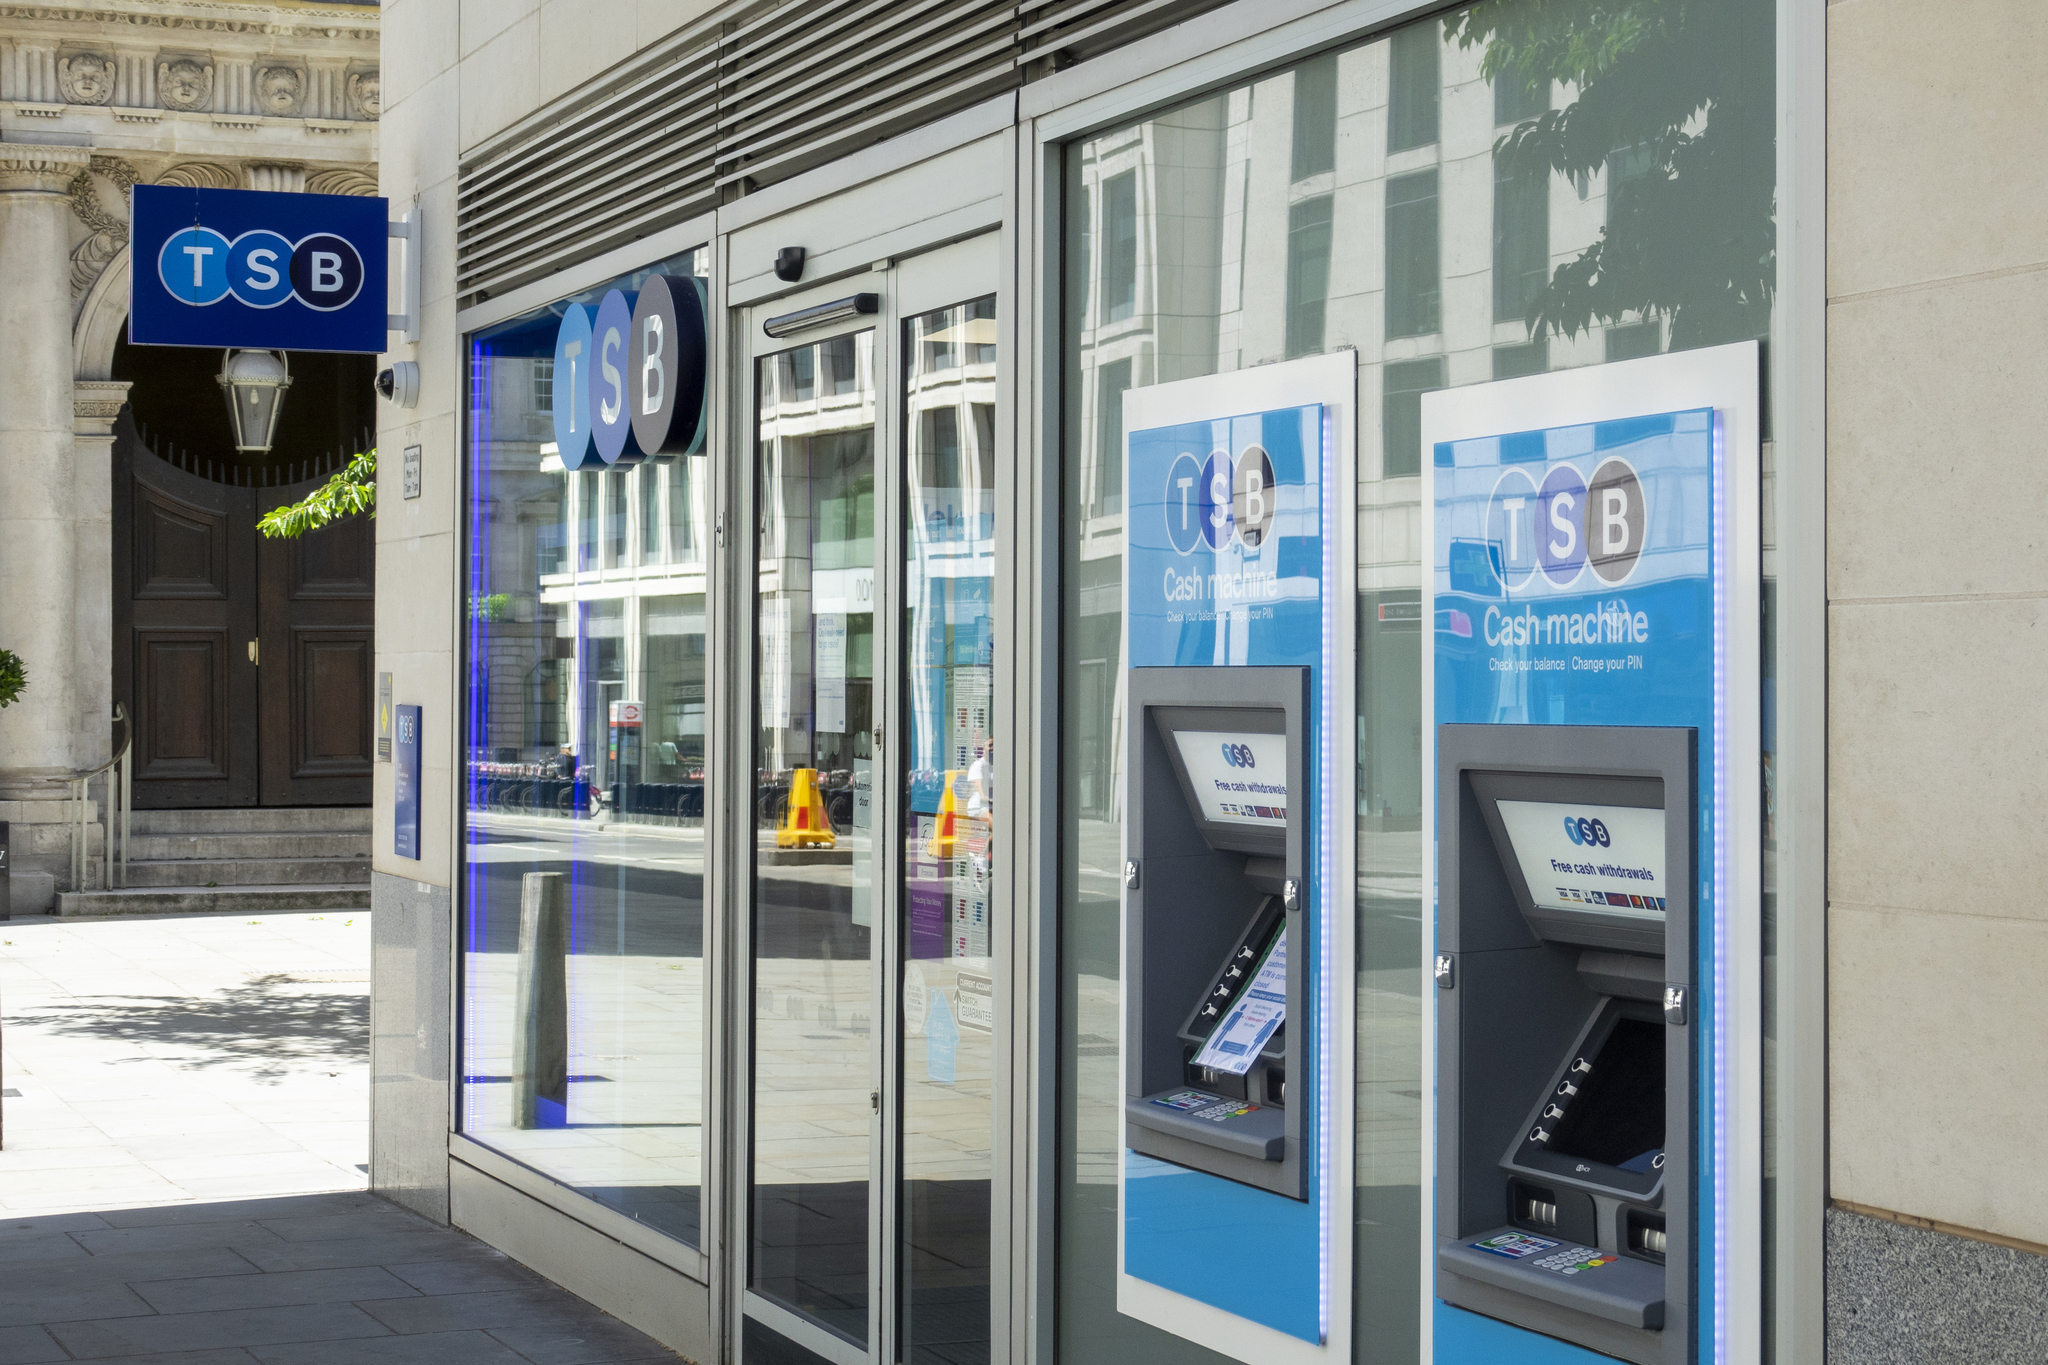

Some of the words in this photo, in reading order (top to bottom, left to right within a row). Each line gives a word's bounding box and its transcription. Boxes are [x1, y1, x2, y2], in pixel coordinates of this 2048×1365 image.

[182, 246, 344, 293] TSB
[564, 314, 665, 434] TSB
[1177, 469, 1265, 530] TSB
[1503, 487, 1630, 561] TSB
[1163, 566, 1203, 602] Cash
[1208, 560, 1277, 600] machine
[1167, 610, 1184, 622] Check
[1185, 611, 1197, 624] your
[1198, 609, 1220, 621] balance
[1224, 608, 1247, 622] Change
[1248, 610, 1261, 622] your
[1262, 607, 1274, 619] PIN
[1483, 604, 1540, 647] Cash
[1547, 601, 1649, 645] machine
[1489, 657, 1514, 672] Check
[1514, 659, 1533, 673] your
[1534, 656, 1566, 671] balance
[1572, 655, 1604, 673] Change
[1606, 657, 1626, 672] your
[1627, 655, 1643, 670] PIN
[1224, 748, 1253, 763] TSB
[1214, 780, 1231, 791] Free
[1231, 782, 1248, 793] cash
[1248, 782, 1286, 795] withdrawals
[859, 796, 869, 807] door
[1568, 823, 1607, 842] TSB
[1550, 859, 1573, 874] Free
[1573, 862, 1597, 876] cash
[1597, 864, 1654, 881] withdrawals
[1260, 970, 1271, 978] ATM
[959, 978, 976, 989] CURRENT
[976, 982, 992, 992] ACCOUNT
[961, 994, 978, 1006] SWITCH
[961, 1005, 992, 1023] GUARANTEE
